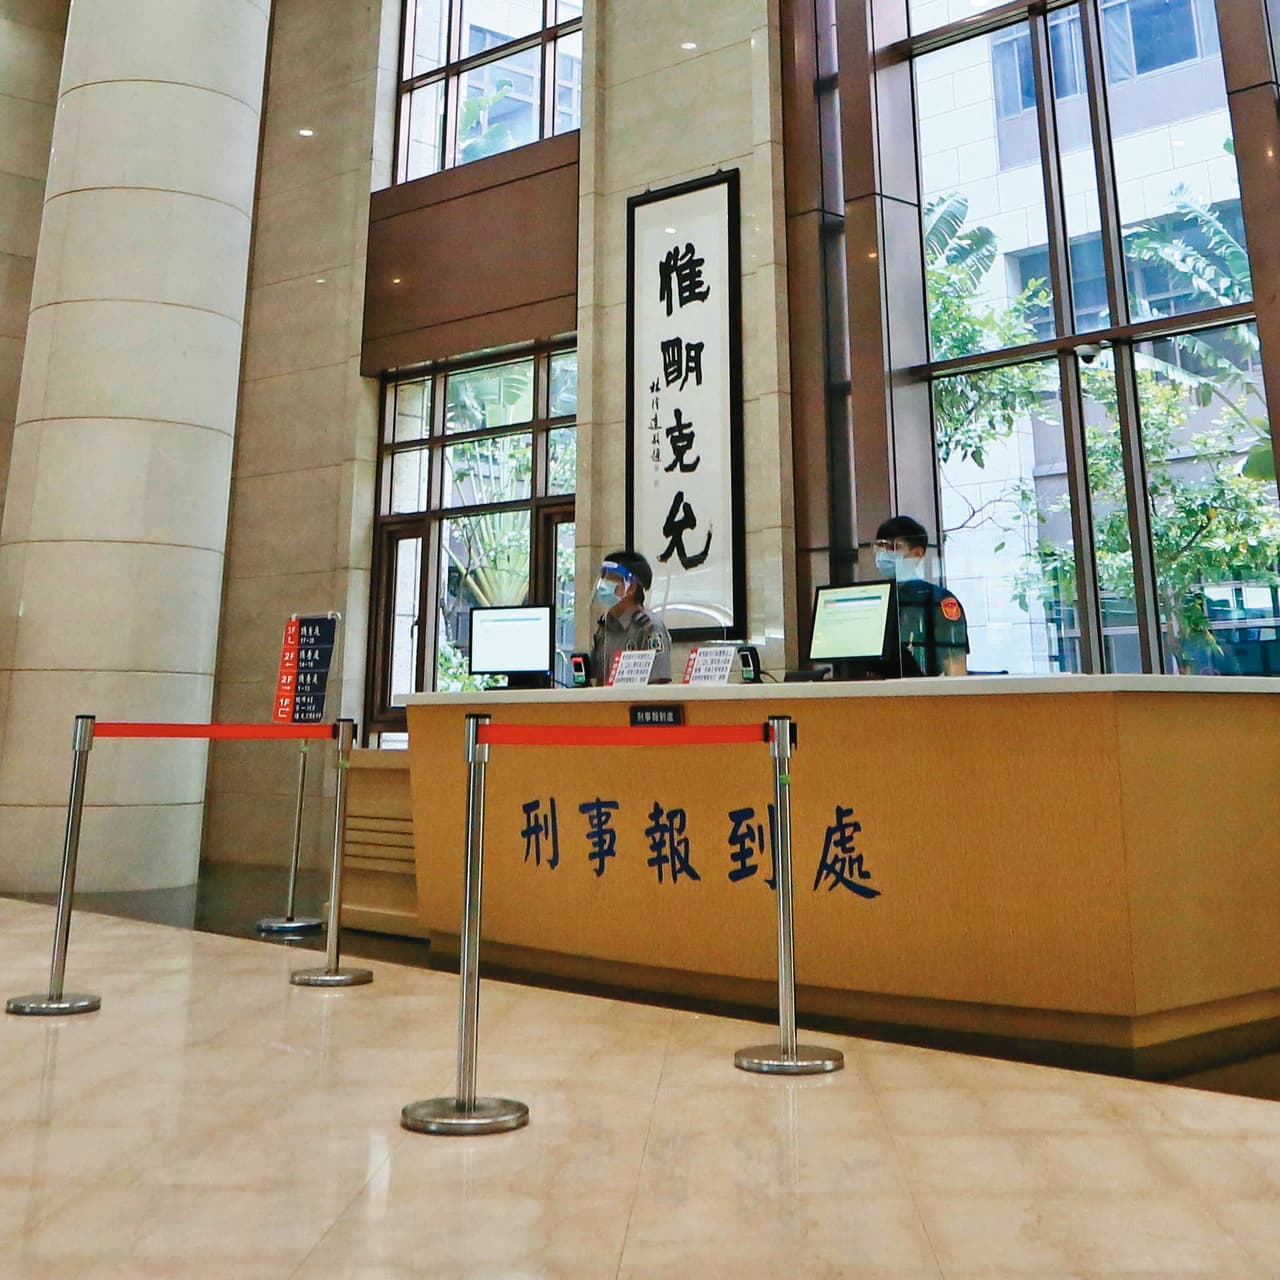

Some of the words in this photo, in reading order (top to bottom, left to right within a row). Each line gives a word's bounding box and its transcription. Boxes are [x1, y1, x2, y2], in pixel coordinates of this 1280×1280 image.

[281, 675, 293, 684] 2F
[280, 698, 290, 707] 1F
[520, 796, 882, 900] 刑事報到處
